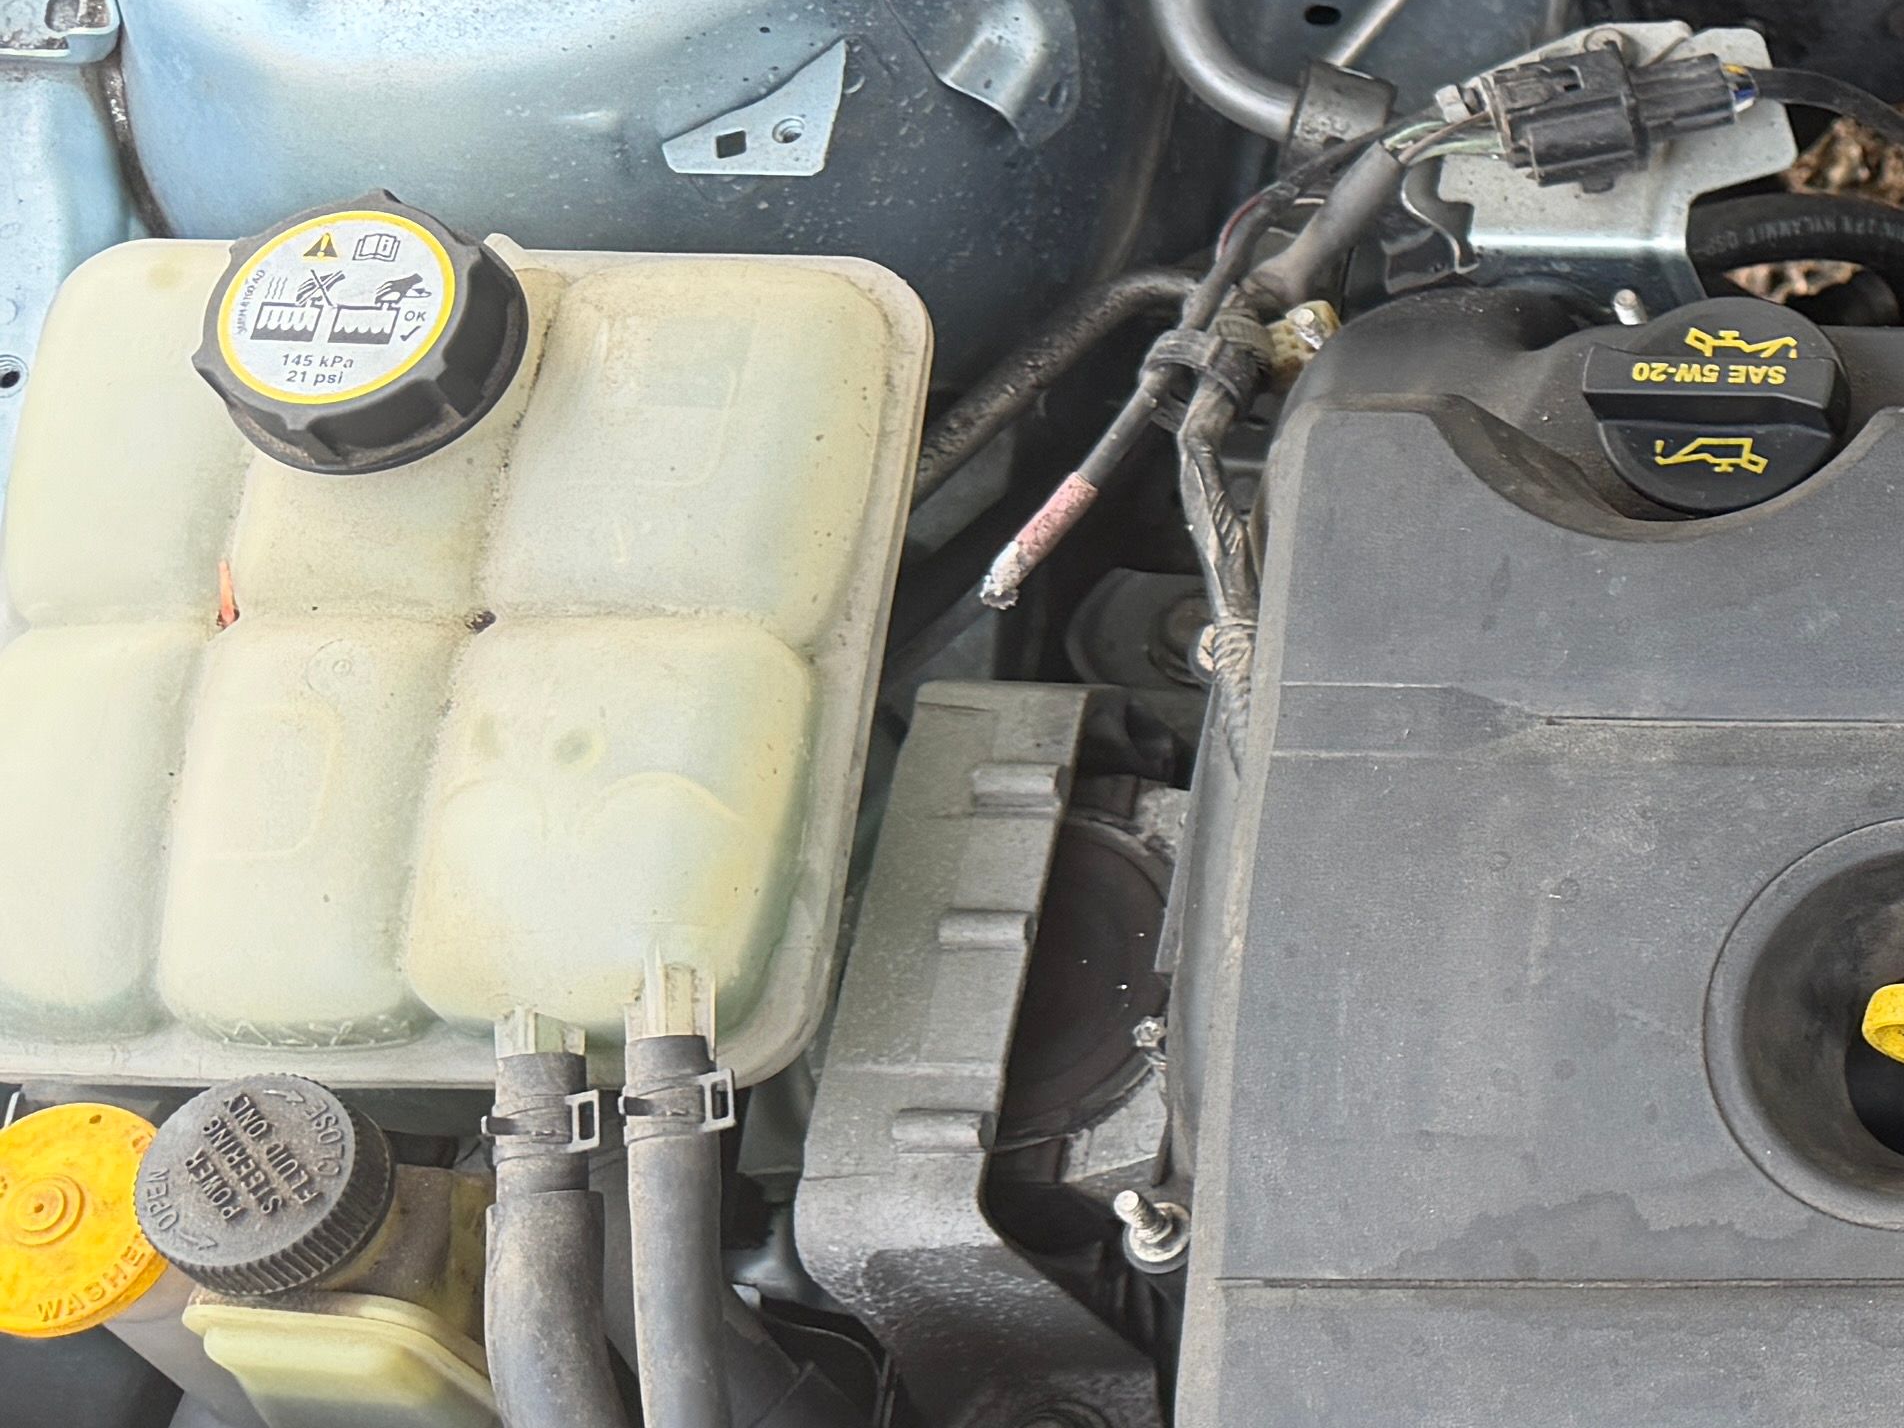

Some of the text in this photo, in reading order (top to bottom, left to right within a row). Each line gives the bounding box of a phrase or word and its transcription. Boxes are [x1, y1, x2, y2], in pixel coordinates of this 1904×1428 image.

[404, 310, 427, 323] OK
[282, 354, 355, 369] 145 kPa
[286, 371, 344, 385] 21 psi
[1632, 362, 1787, 385] SAE 5W-20
[203, 1115, 283, 1216] STEERING
[223, 1092, 323, 1205] FLUID ONLY
[304, 1098, 347, 1178] CLOSE
[144, 1168, 180, 1232] OPEN
[185, 1146, 246, 1224] POWER
[37, 1238, 150, 1322] WASHE
